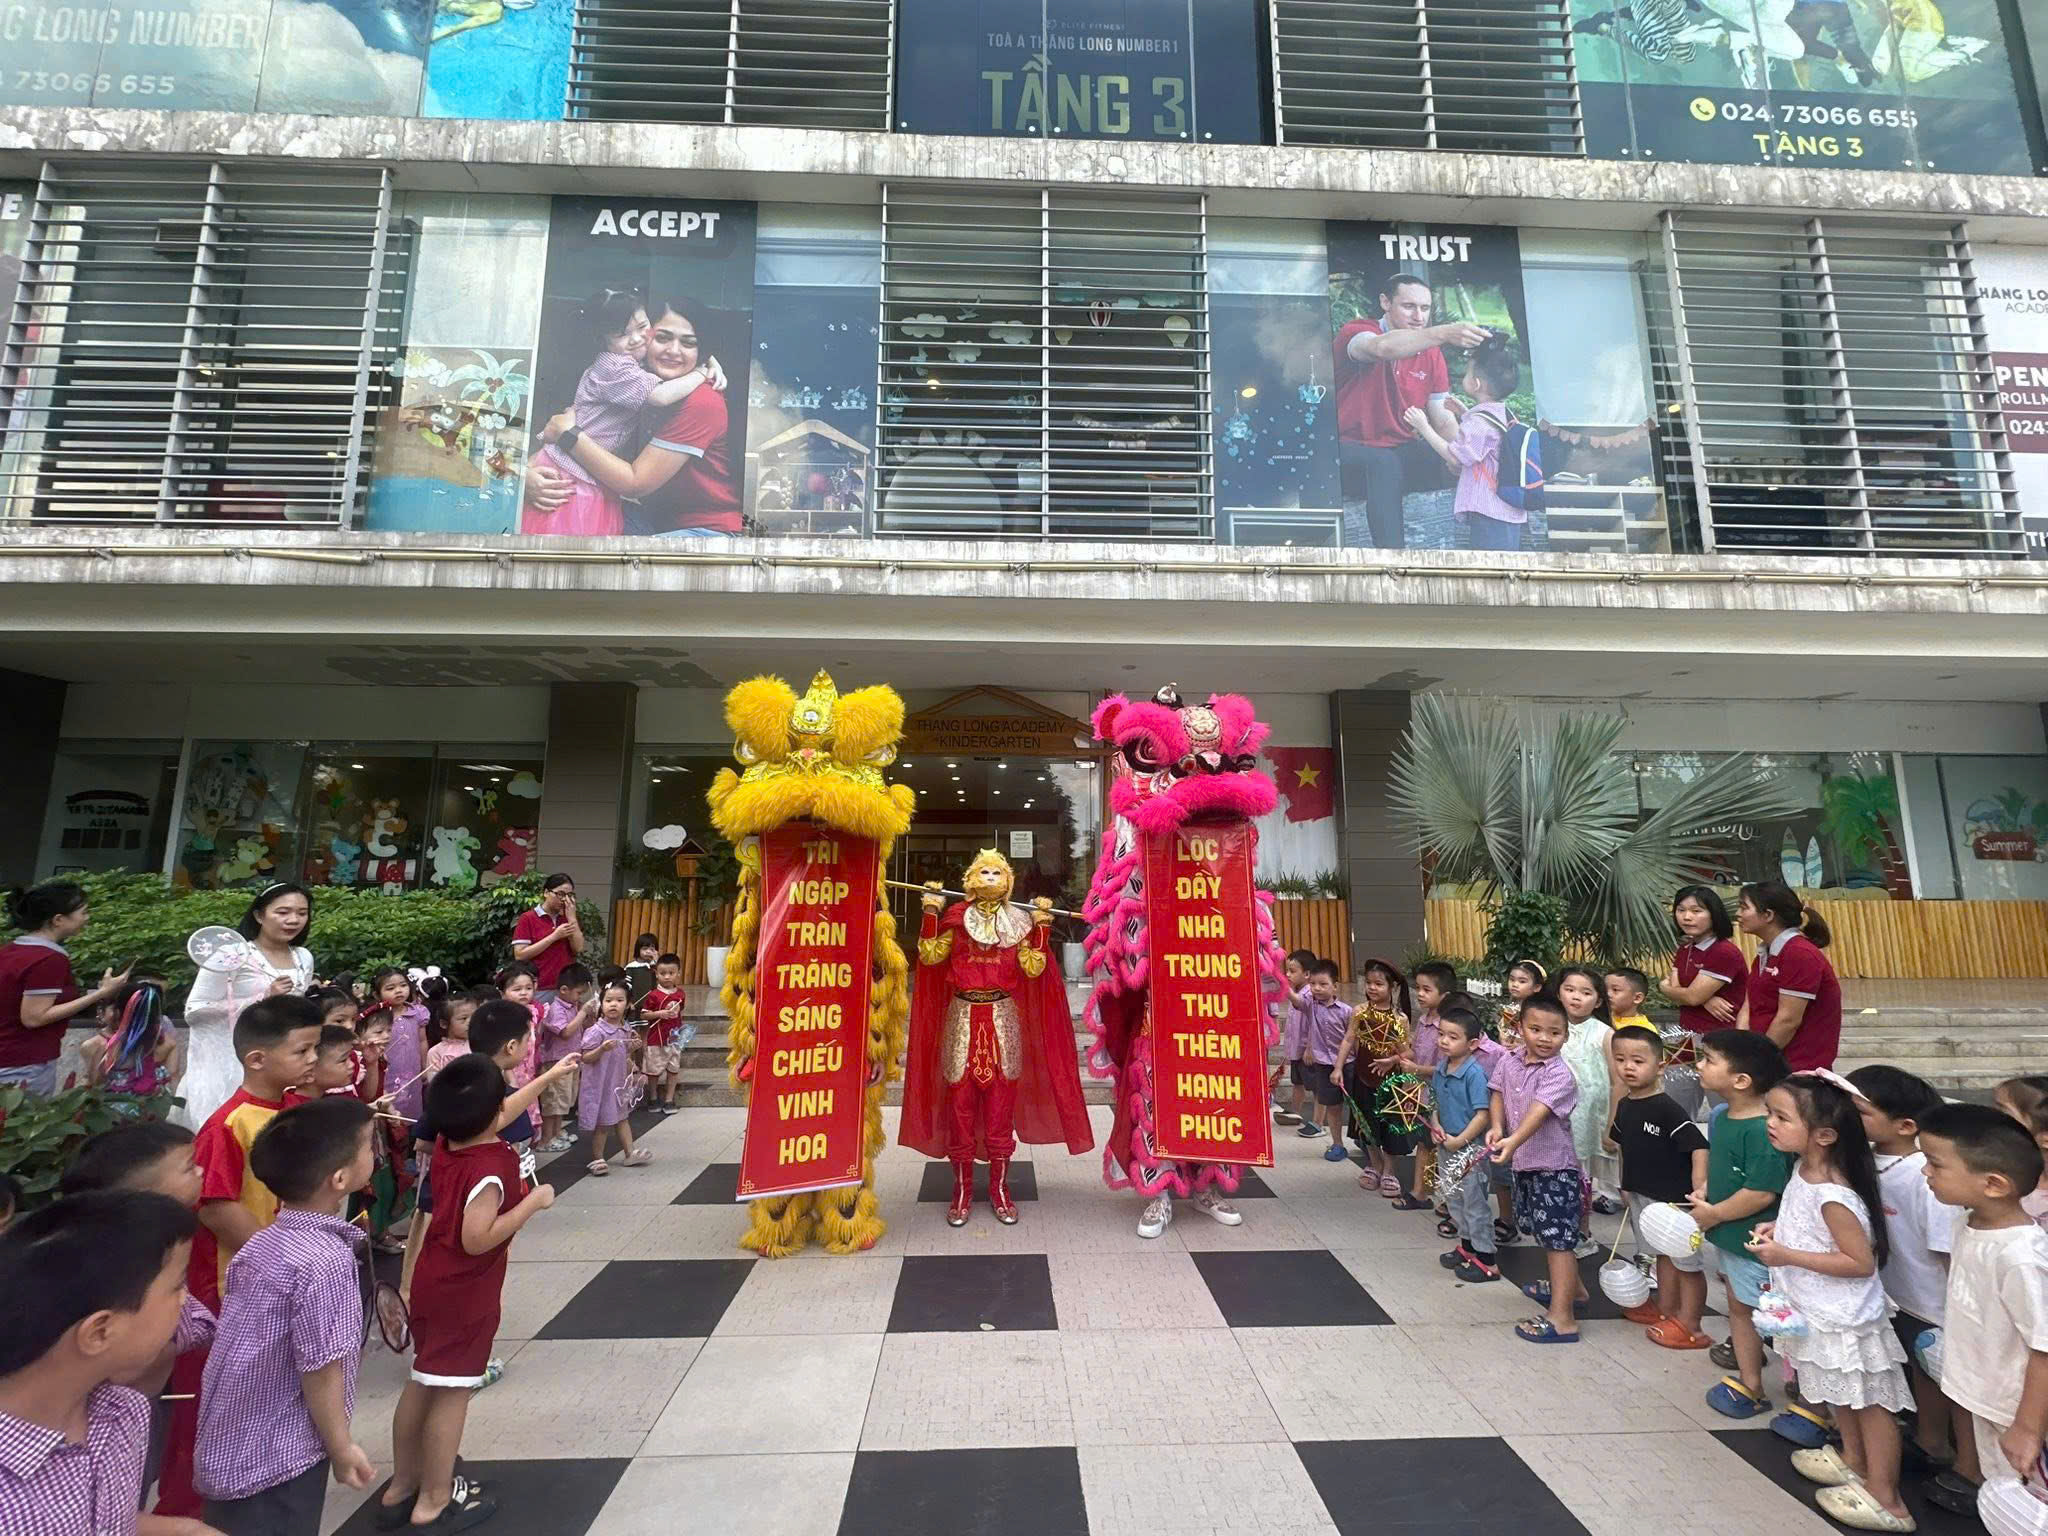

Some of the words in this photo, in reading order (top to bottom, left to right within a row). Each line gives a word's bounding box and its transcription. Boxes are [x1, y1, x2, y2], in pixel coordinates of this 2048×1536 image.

[33, 7, 121, 45] LONG
[128, 10, 263, 49] NUMBER
[1079, 37, 1113, 51] LONG
[15, 71, 111, 93] 73066
[120, 74, 175, 95] 655
[981, 53, 1130, 134] TẦNG
[1152, 76, 1186, 135] 3
[1721, 102, 1771, 122] 024
[1781, 105, 1862, 126] 73066
[1869, 109, 1918, 128] 655
[1847, 137, 1864, 158] 3
[590, 209, 720, 239] ACCEPT
[1379, 234, 1472, 262] TRUST
[1979, 287, 2022, 300] HANG
[1975, 366, 2048, 388] PEN
[963, 719, 999, 733] LONG
[1000, 719, 1066, 733] ACADEMY
[939, 735, 1041, 749] KINDERGARTEN
[802, 832, 839, 865] TÀI
[1177, 835, 1218, 866] LỘC
[788, 876, 849, 910] NGẬP
[1175, 869, 1222, 899] ĐẦY
[787, 912, 847, 947] TRÀN
[1178, 906, 1225, 938] NHÀ
[776, 958, 852, 989] TRĂNG
[1163, 953, 1242, 978] TRUNG
[777, 997, 842, 1033] SÁNG
[1181, 993, 1229, 1019] THU
[772, 1039, 843, 1077] CHIẾU
[1173, 1029, 1241, 1059] THÊM
[1177, 1072, 1241, 1104] HẠNH
[777, 1089, 834, 1121] VINH
[1180, 1108, 1243, 1143] PHÚC
[778, 1133, 827, 1166] HOA
